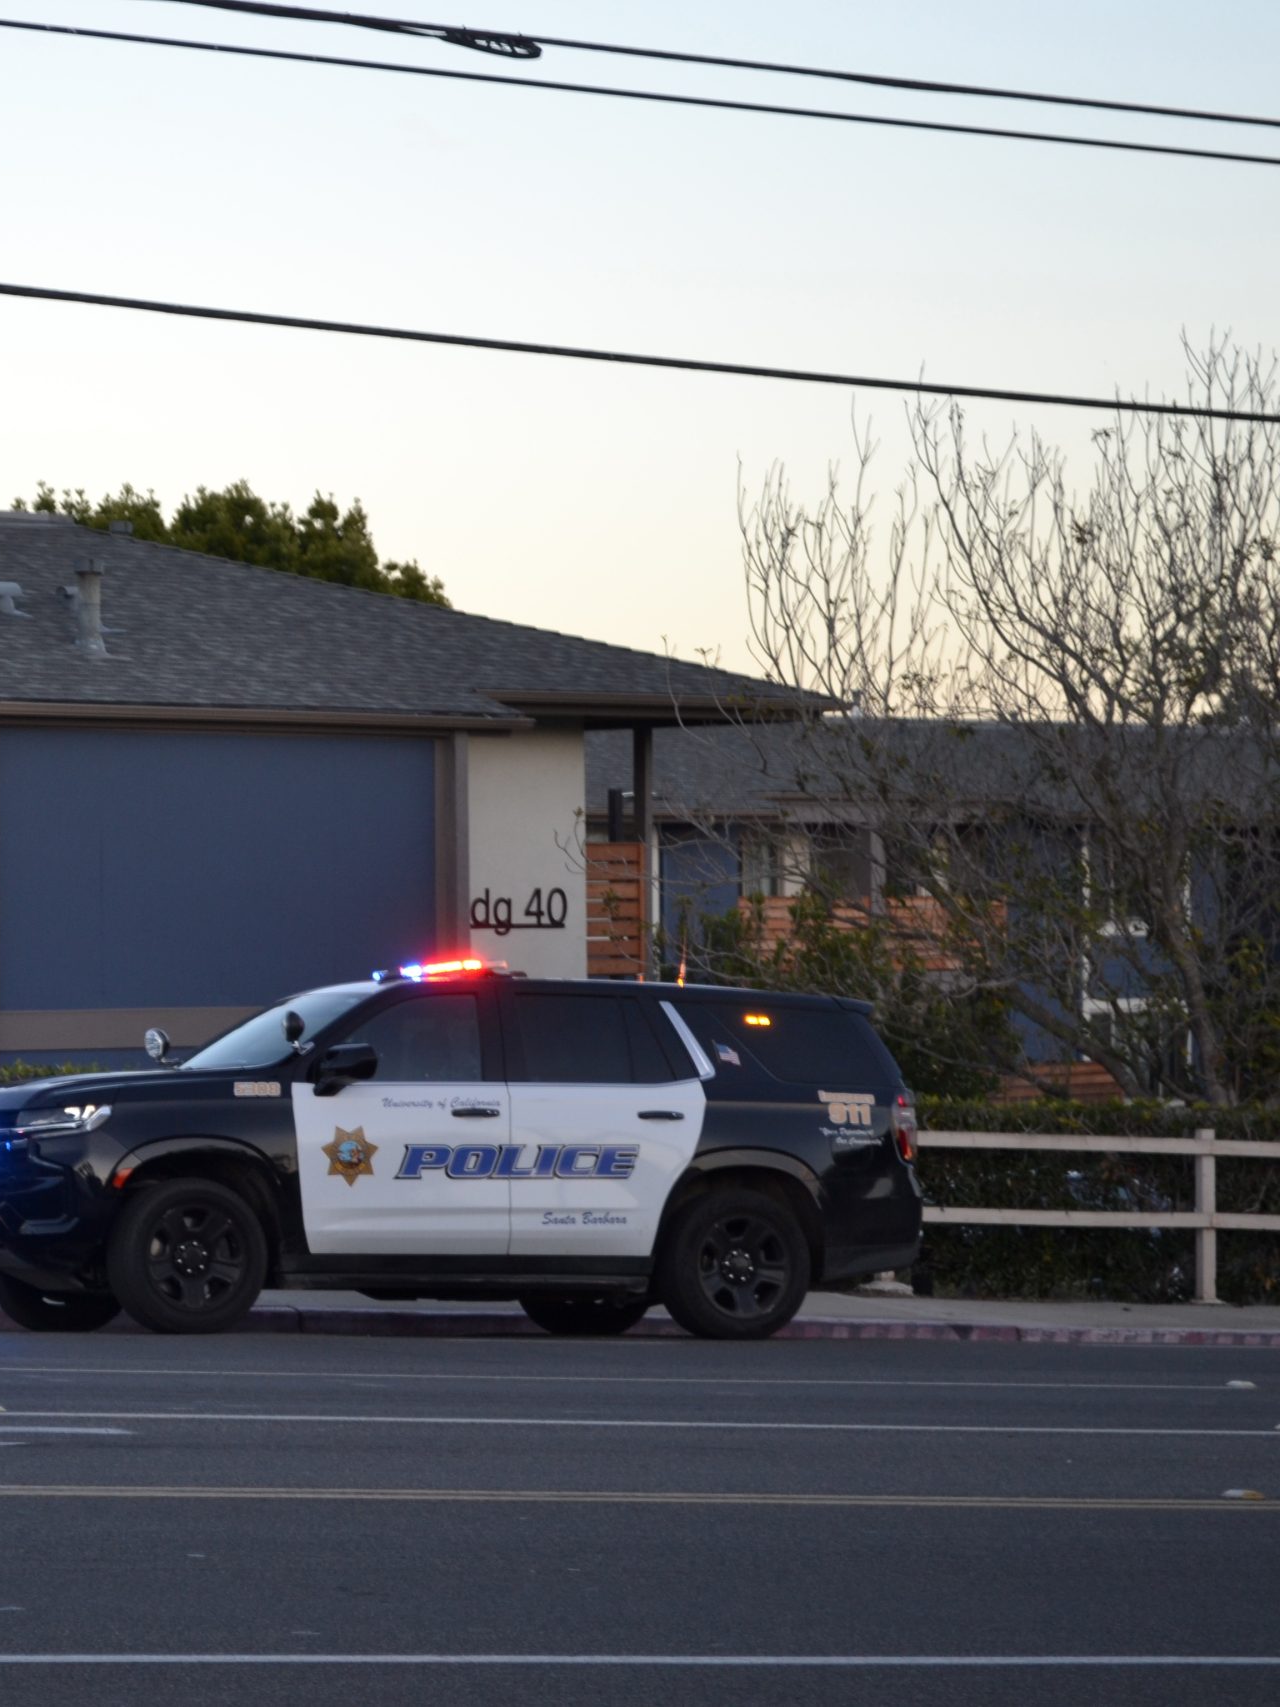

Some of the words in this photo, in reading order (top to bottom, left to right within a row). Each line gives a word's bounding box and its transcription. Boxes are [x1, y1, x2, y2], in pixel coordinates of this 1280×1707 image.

[470, 887, 512, 936] dg
[524, 887, 568, 928] 40
[381, 1097, 433, 1109] University
[450, 1096, 501, 1109] California
[828, 1102, 872, 1126] 911
[393, 1143, 640, 1180] POLICE
[541, 1211, 577, 1225] Santa
[581, 1211, 627, 1225] Barbara
